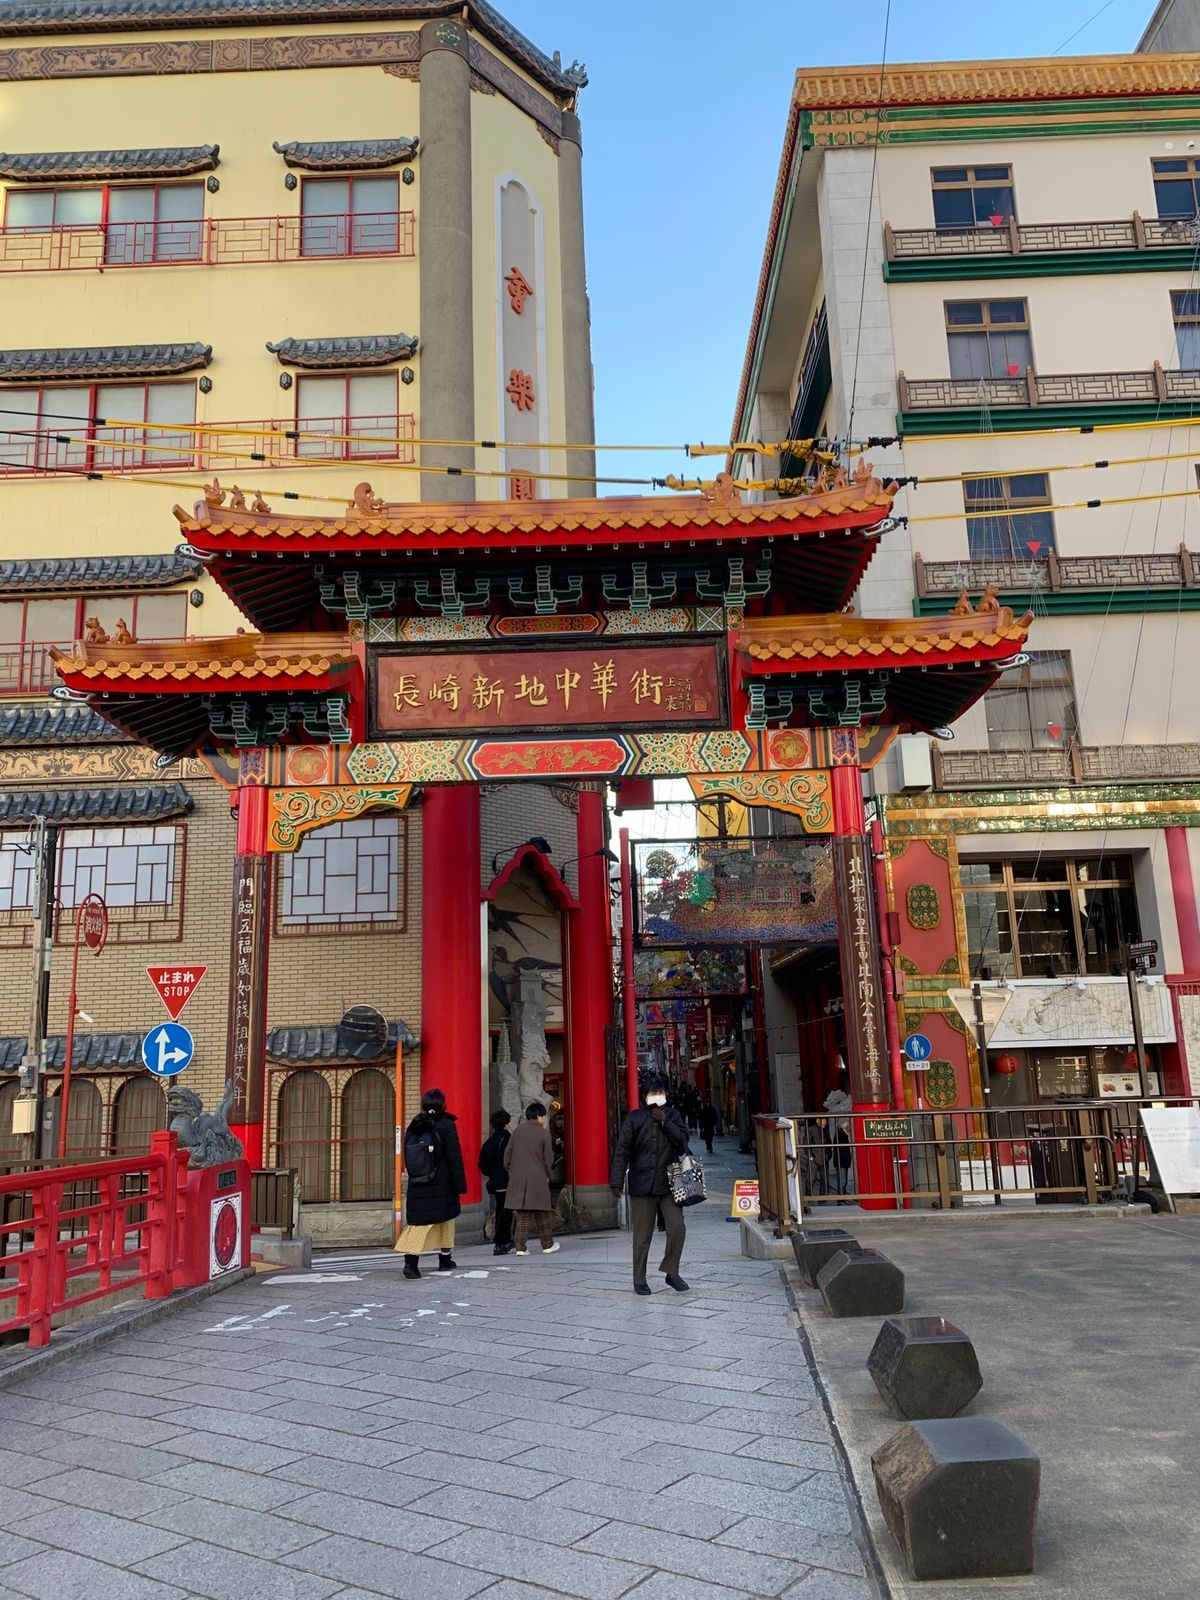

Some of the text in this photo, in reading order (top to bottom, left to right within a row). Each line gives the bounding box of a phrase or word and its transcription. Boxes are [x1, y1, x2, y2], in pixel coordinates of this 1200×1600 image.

[394, 659, 664, 714] 長崎新地中華街
[158, 971, 195, 985] 止まれ
[164, 986, 190, 997] STOP
